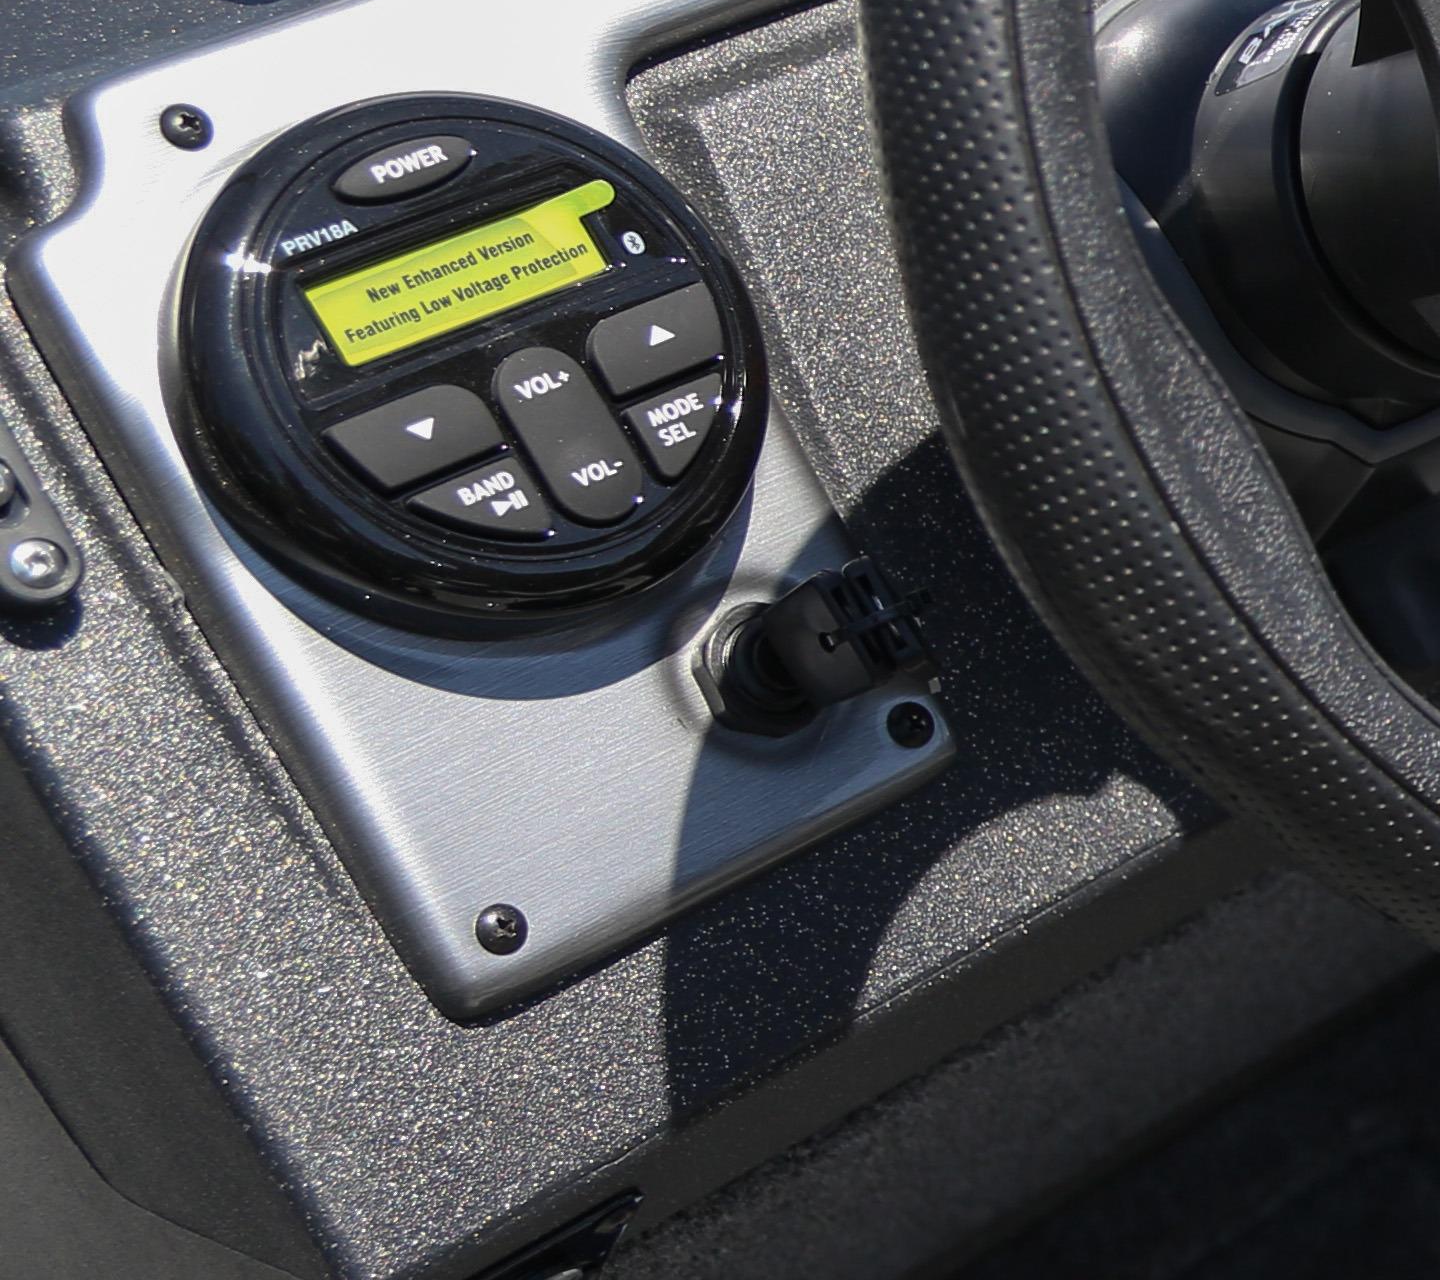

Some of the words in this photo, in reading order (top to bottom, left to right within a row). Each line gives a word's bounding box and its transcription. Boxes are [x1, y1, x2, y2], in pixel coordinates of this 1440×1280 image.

[370, 145, 448, 184] POWER
[281, 218, 358, 256] PRV18A
[366, 276, 401, 304] New
[402, 252, 477, 291] Enhanced
[479, 231, 534, 263] Version
[345, 307, 421, 343] Featuring
[424, 293, 452, 316] Low
[454, 272, 511, 303] Voltage
[512, 240, 588, 281] Protection
[514, 369, 571, 400] VOL+
[646, 393, 705, 428] MODE
[657, 422, 697, 447] SEL
[458, 471, 516, 508] BAND
[571, 459, 624, 488] VOL-
